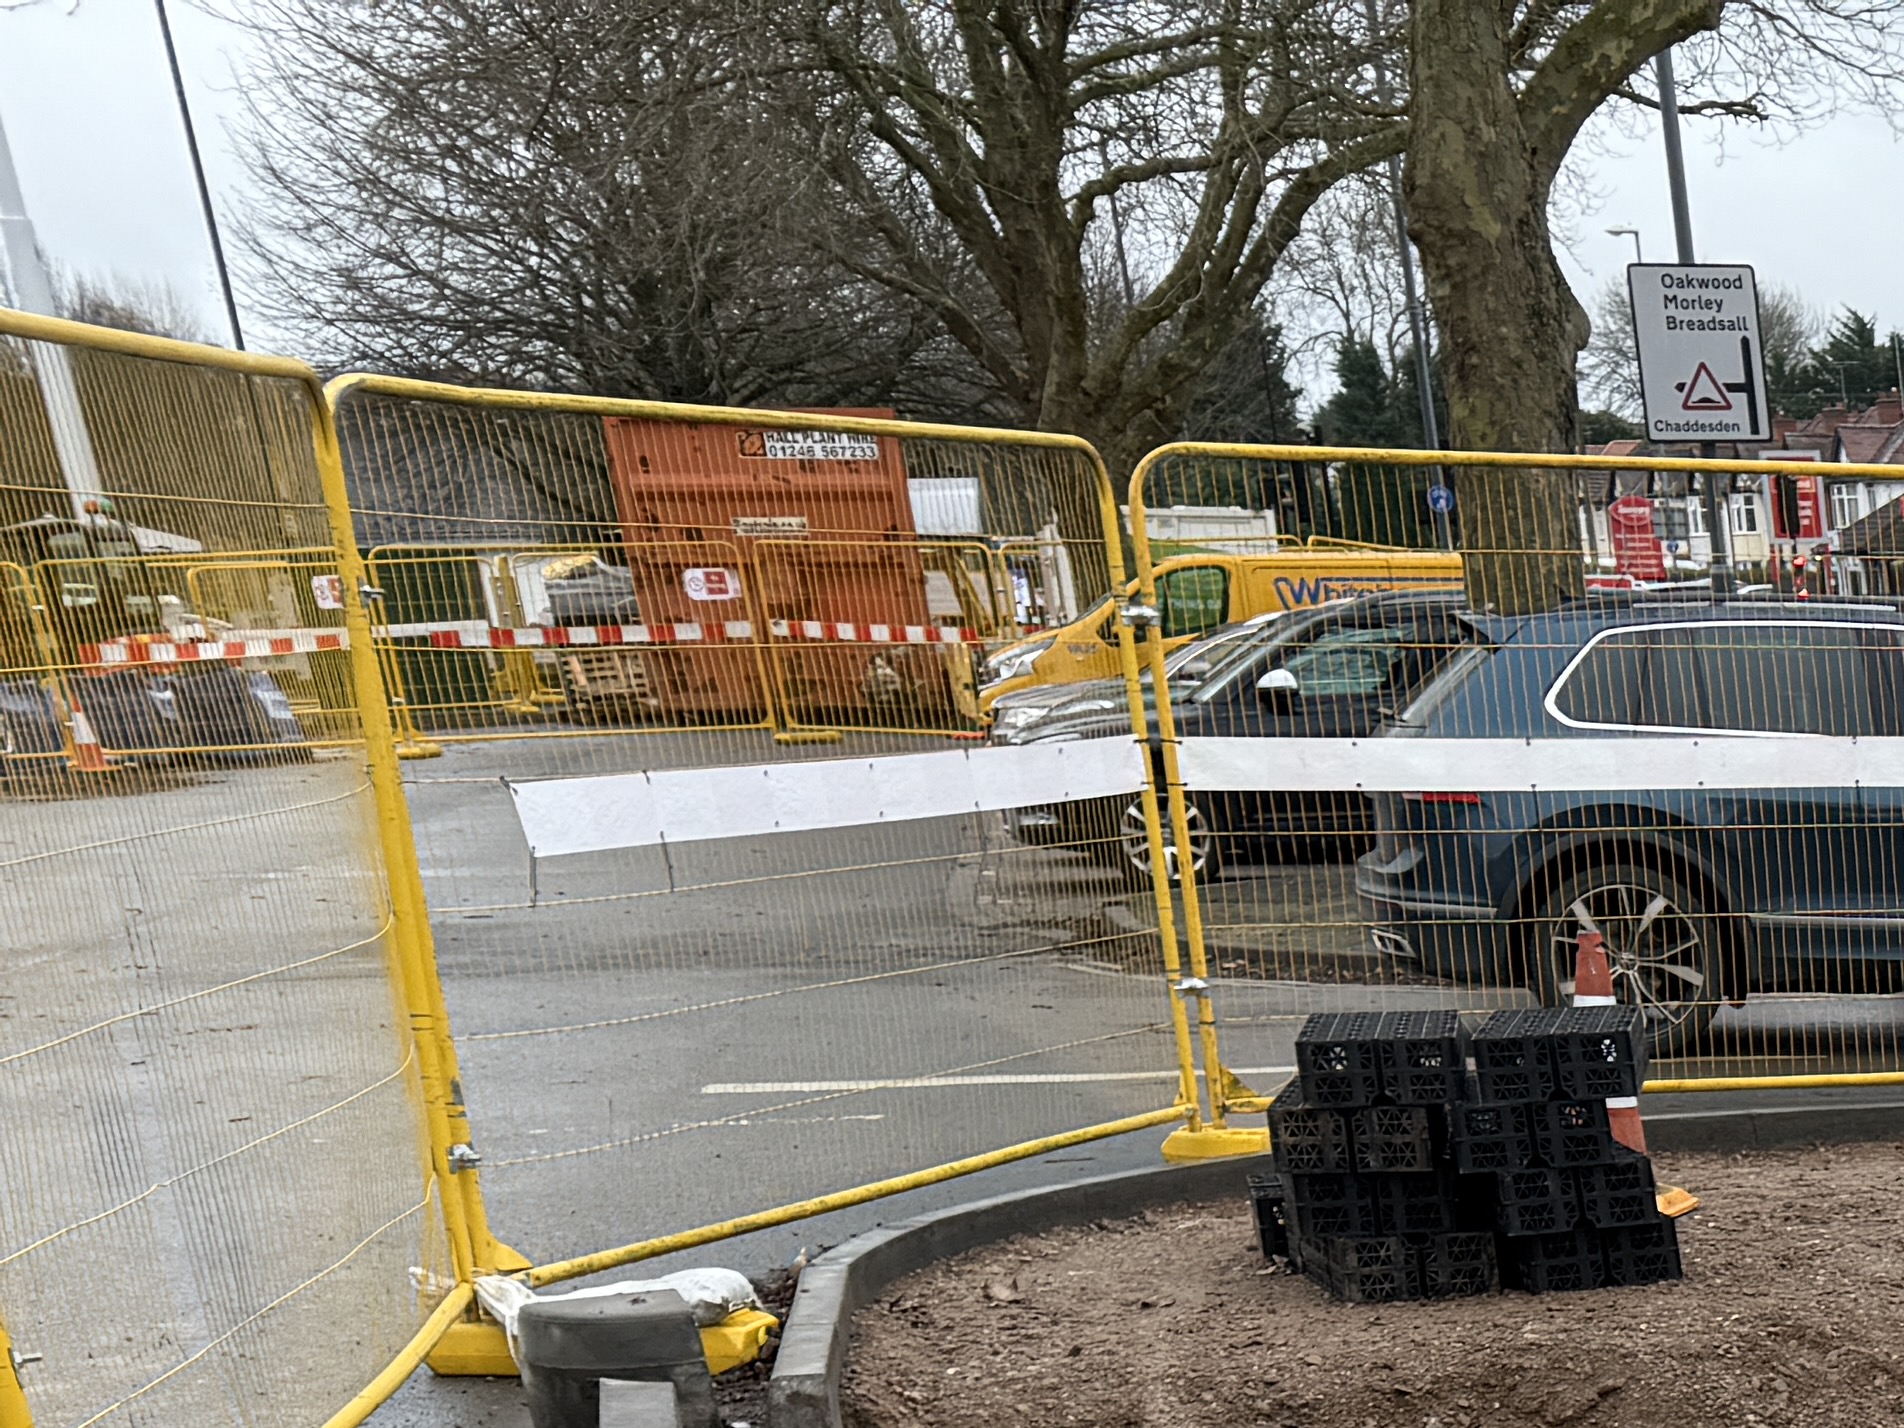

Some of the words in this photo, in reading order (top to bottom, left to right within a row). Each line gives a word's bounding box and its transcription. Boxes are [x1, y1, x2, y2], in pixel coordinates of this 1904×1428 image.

[1661, 273, 1743, 290] Oakwood
[1663, 294, 1723, 313] Morley
[1666, 316, 1749, 332] Breadsall
[1653, 420, 1741, 433] Chaddesden
